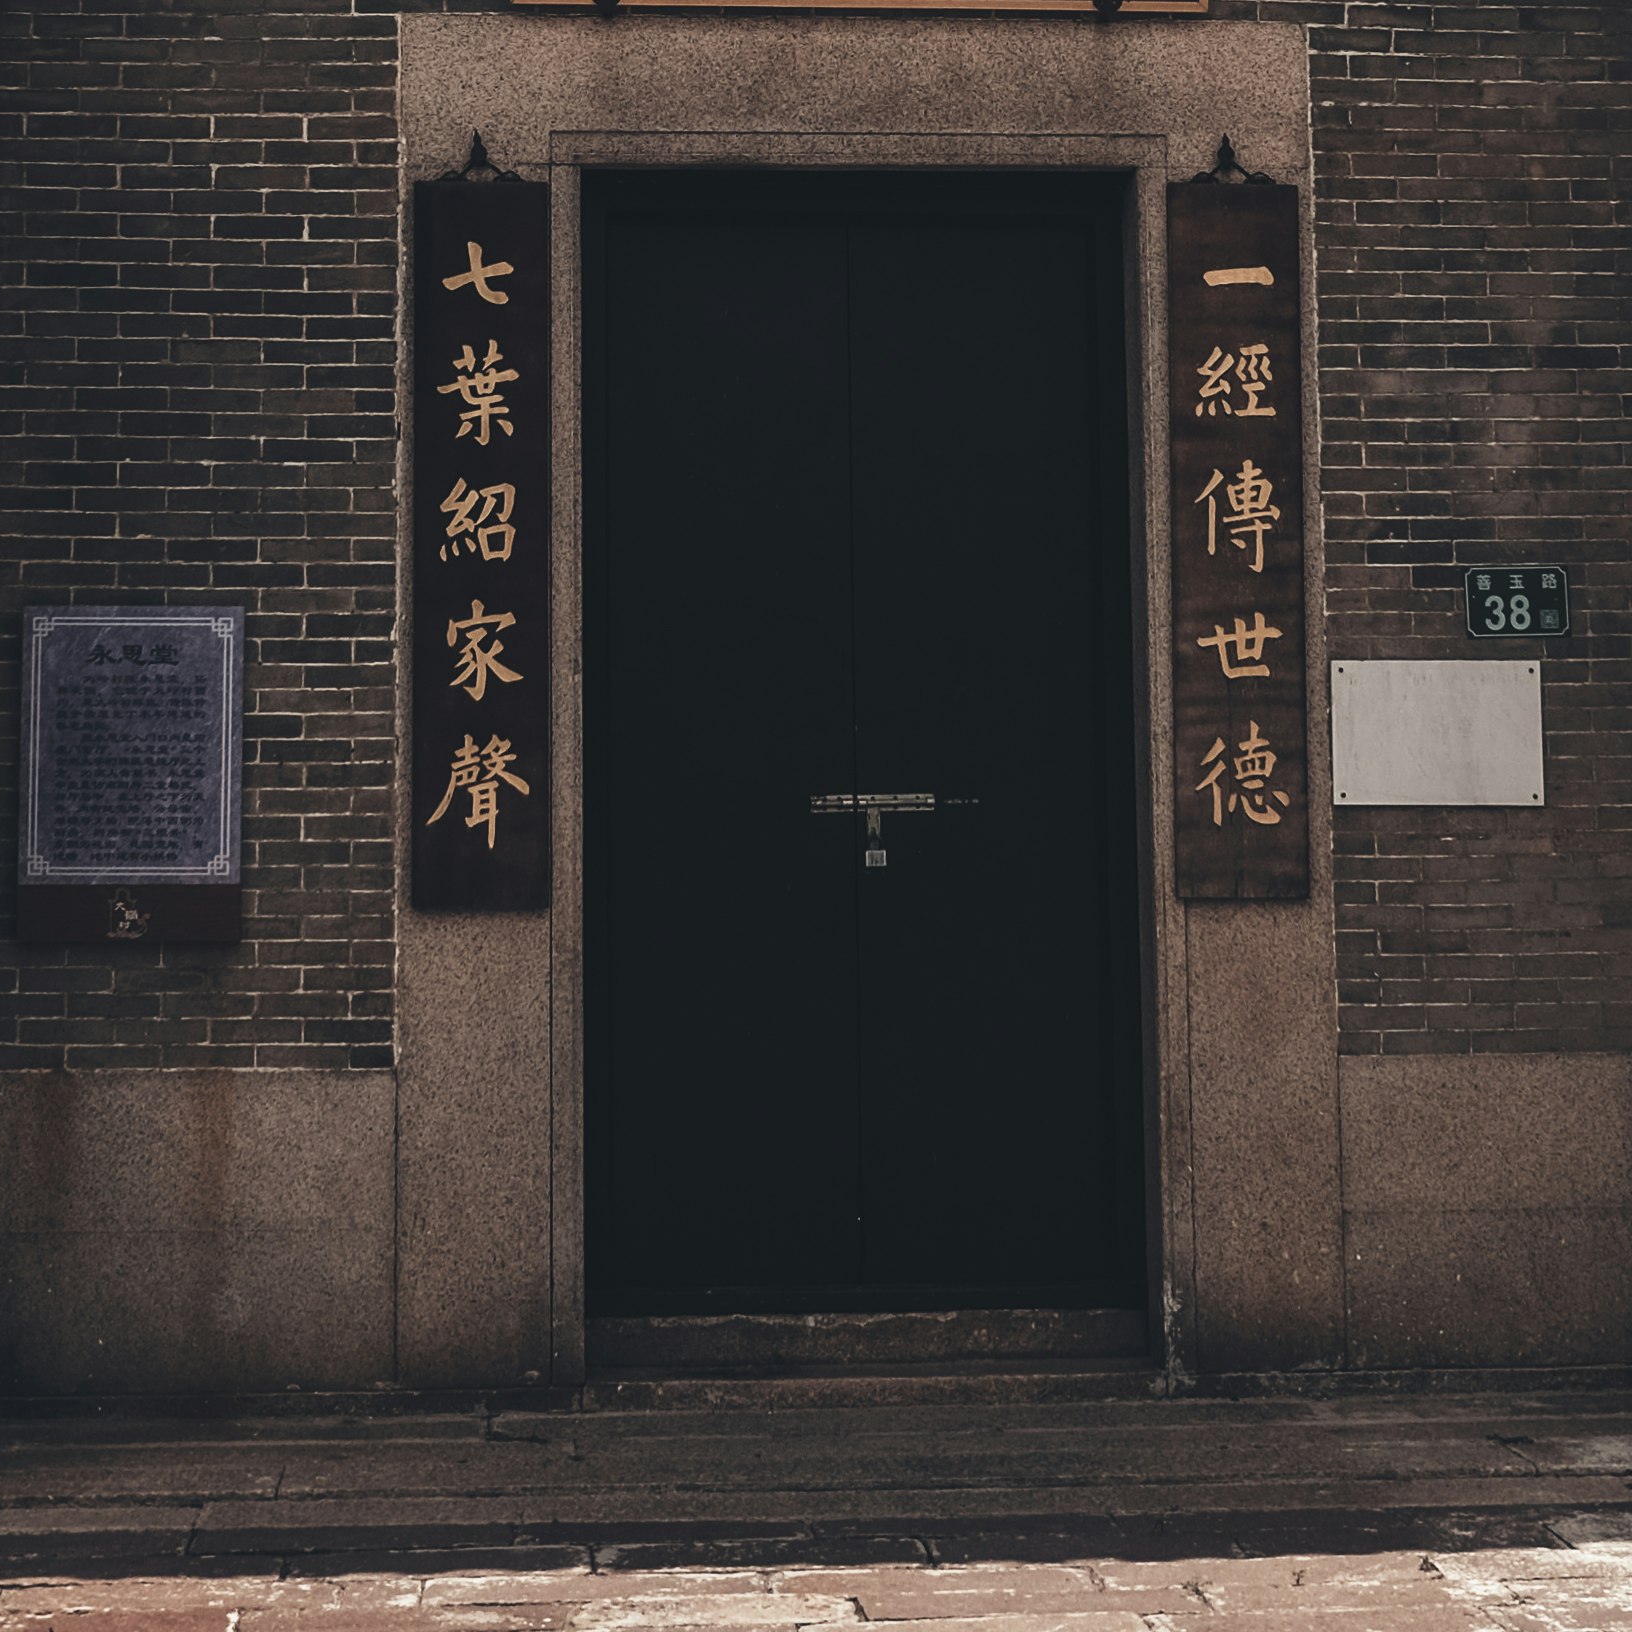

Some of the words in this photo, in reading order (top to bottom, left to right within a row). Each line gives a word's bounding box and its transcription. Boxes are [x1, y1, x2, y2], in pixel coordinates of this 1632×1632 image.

[85, 644, 179, 666] 永思堂
[425, 240, 531, 850] 七葉紹家聲
[1194, 265, 1290, 827] 一經傳世德
[1484, 594, 1532, 631] 38
